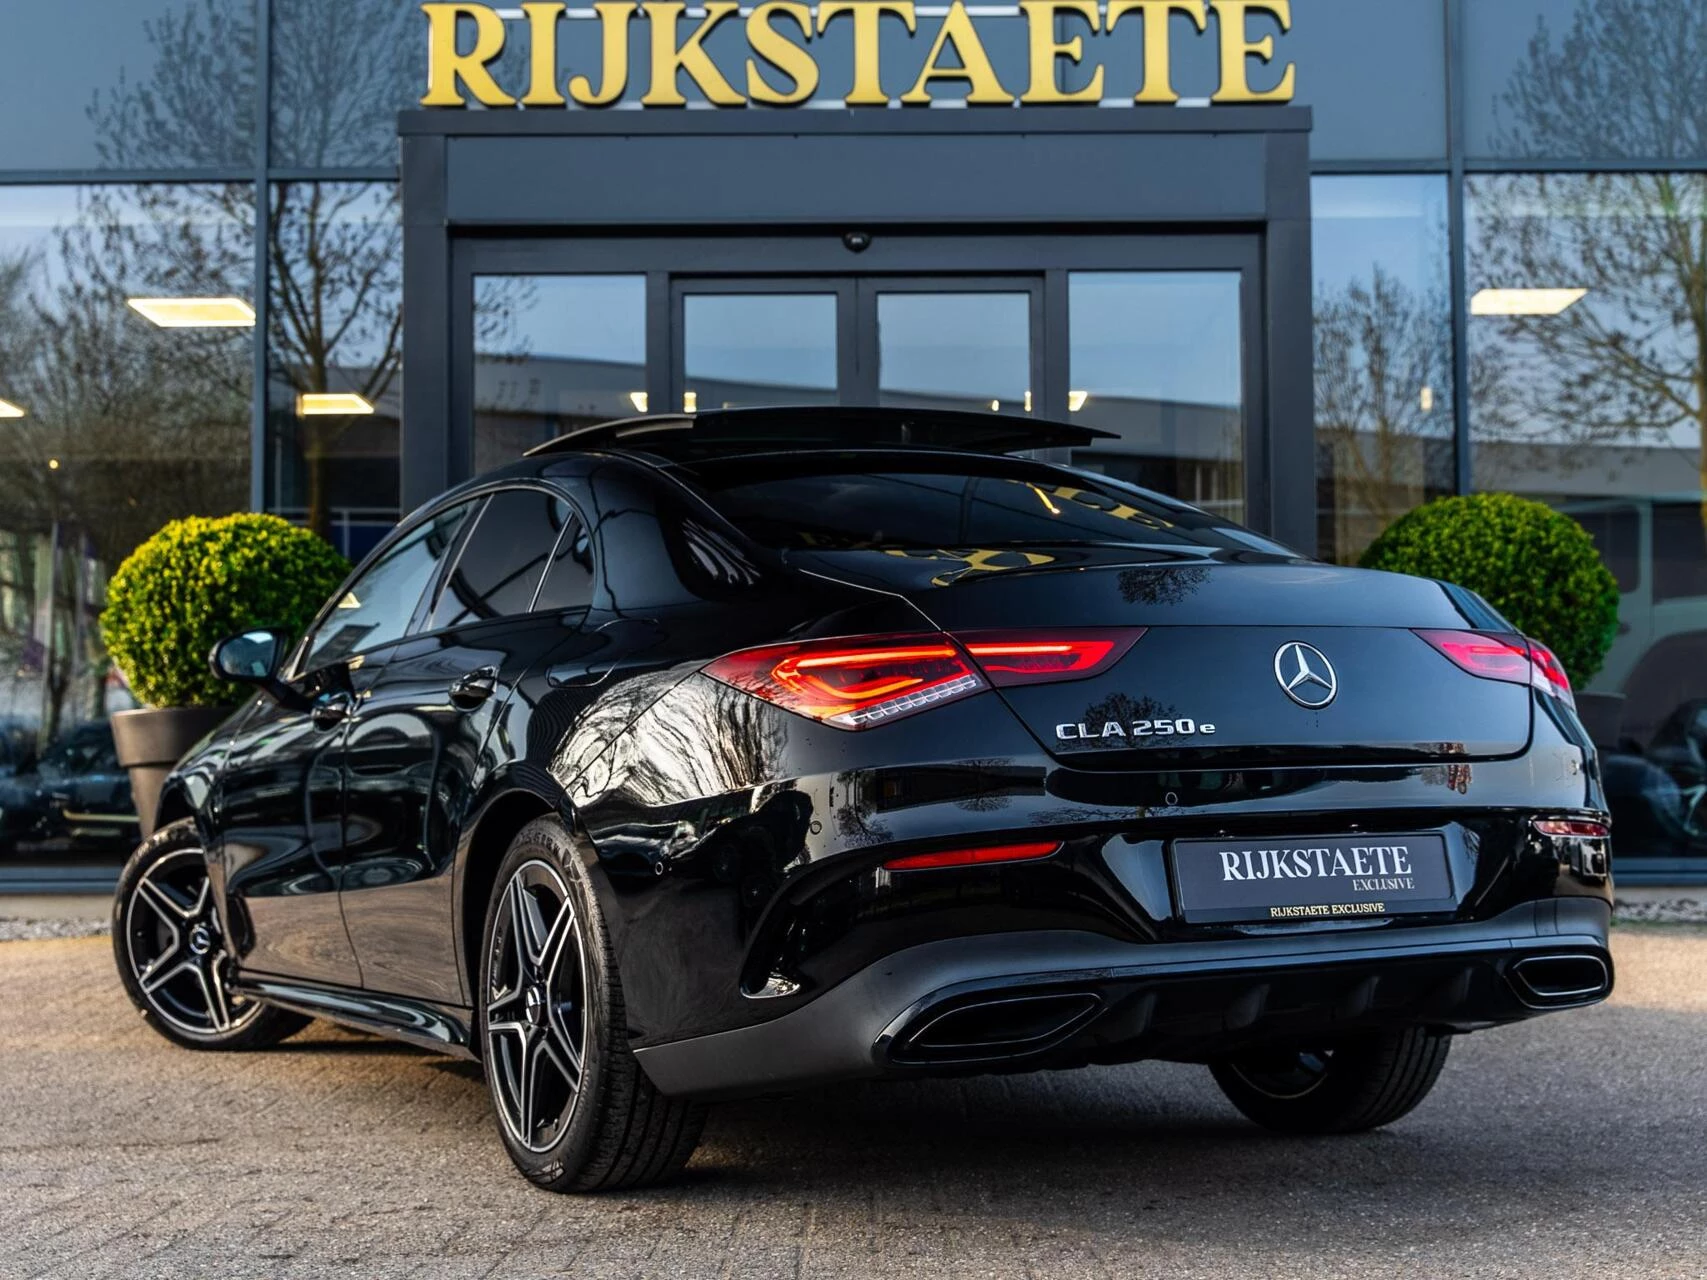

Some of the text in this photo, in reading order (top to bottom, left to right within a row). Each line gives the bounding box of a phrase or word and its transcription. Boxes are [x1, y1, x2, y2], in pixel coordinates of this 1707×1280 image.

[420, 0, 1296, 107] RIJKSTAETE
[1056, 721, 1126, 740] CLA
[1219, 846, 1412, 881] RIJKSTAETE
[1353, 878, 1415, 891] EXCLUSIVE
[1270, 902, 1385, 917] RIJKSTAETE EXCLUSIVE
